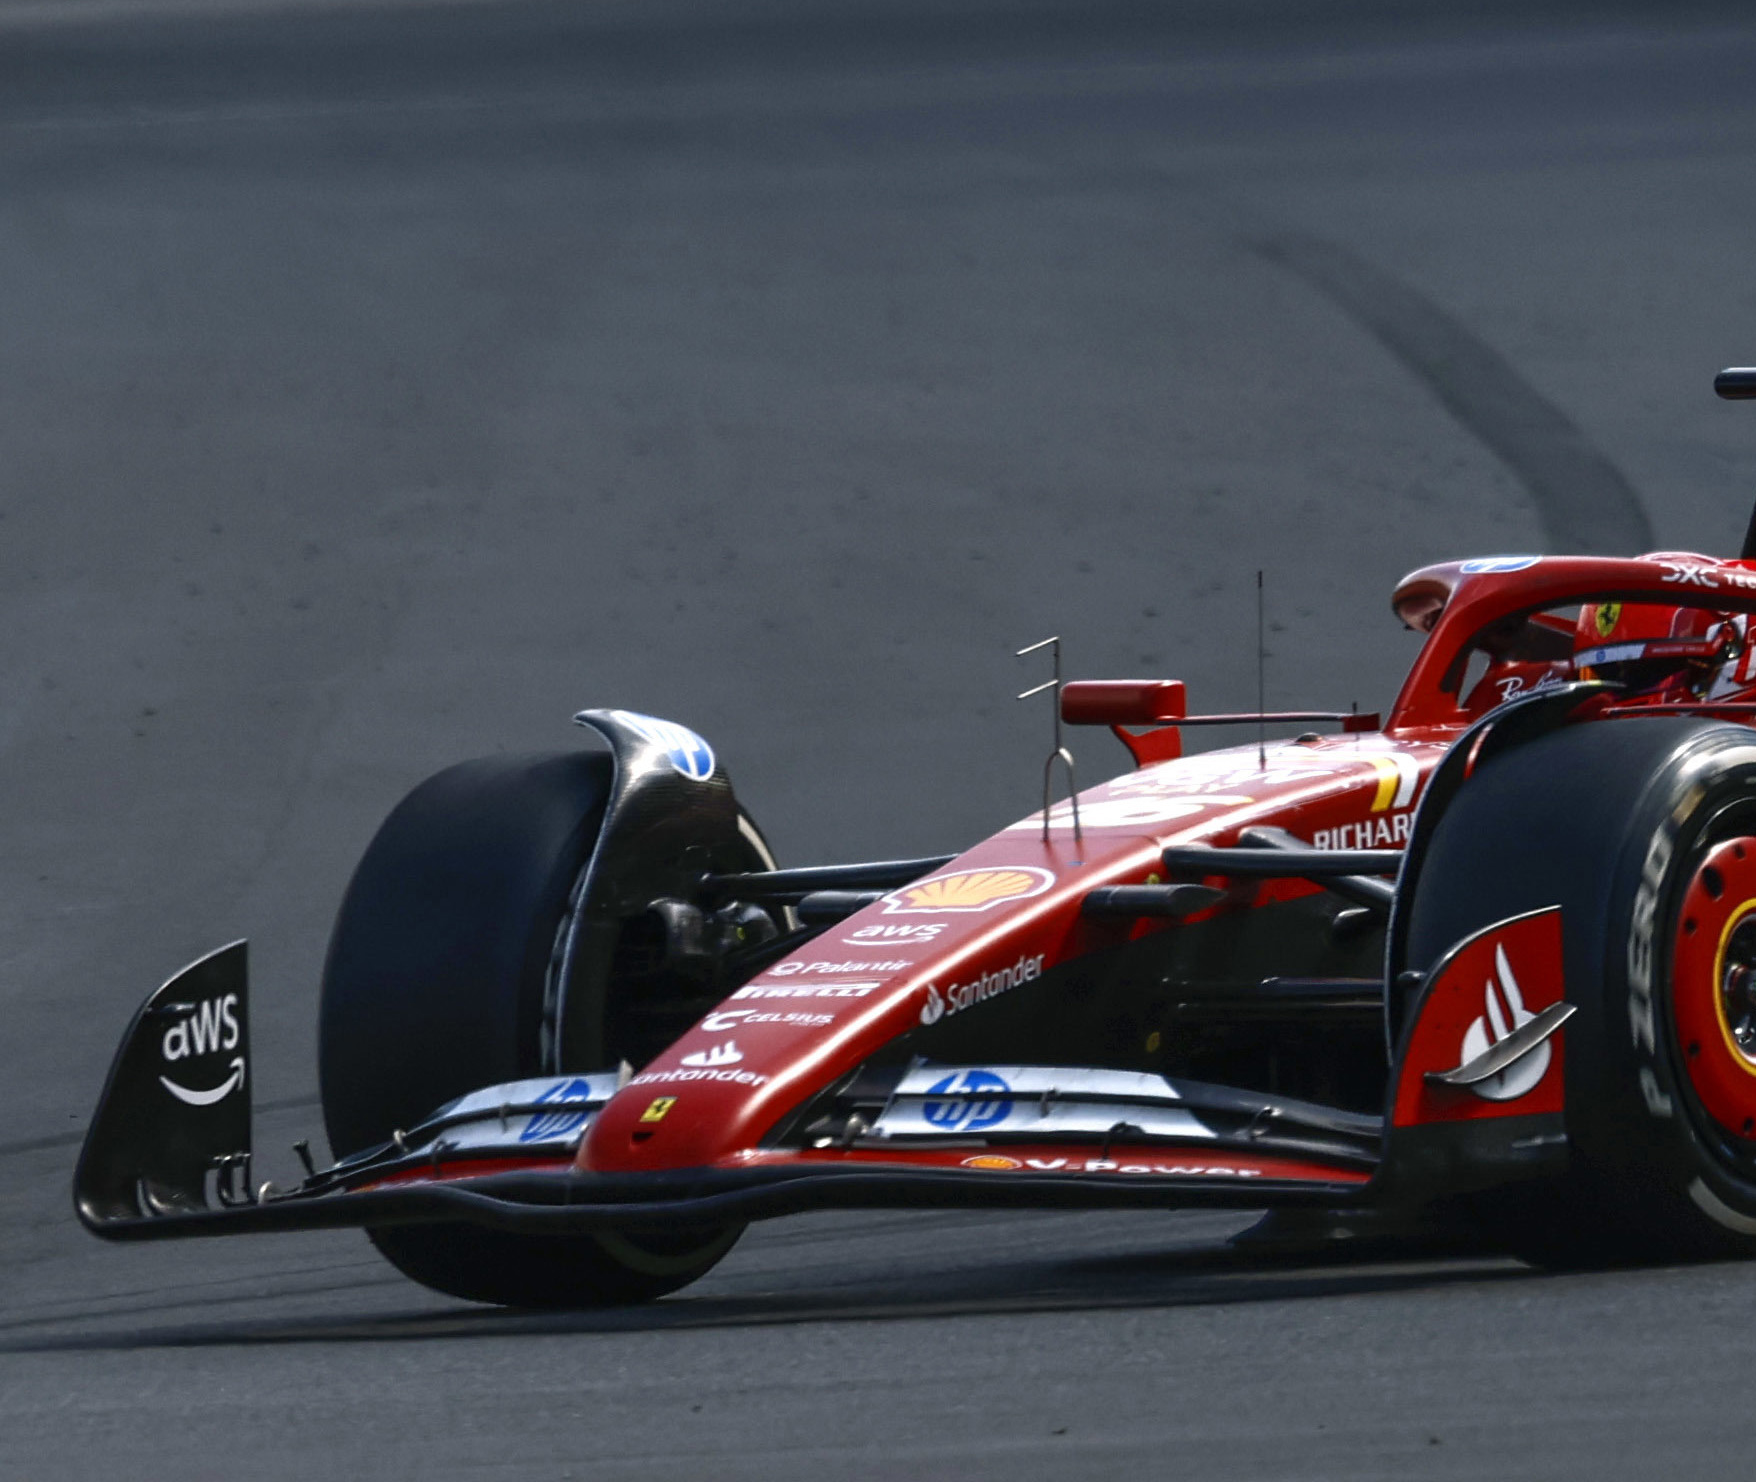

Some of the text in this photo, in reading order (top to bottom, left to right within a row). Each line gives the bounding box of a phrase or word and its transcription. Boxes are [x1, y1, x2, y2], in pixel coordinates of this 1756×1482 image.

[853, 923, 949, 938] aws
[802, 960, 914, 975] Palantir
[946, 953, 1045, 1016] Santander
[163, 994, 238, 1061] aws
[631, 1068, 770, 1087] antander
[1025, 1157, 1263, 1178] V-Power
